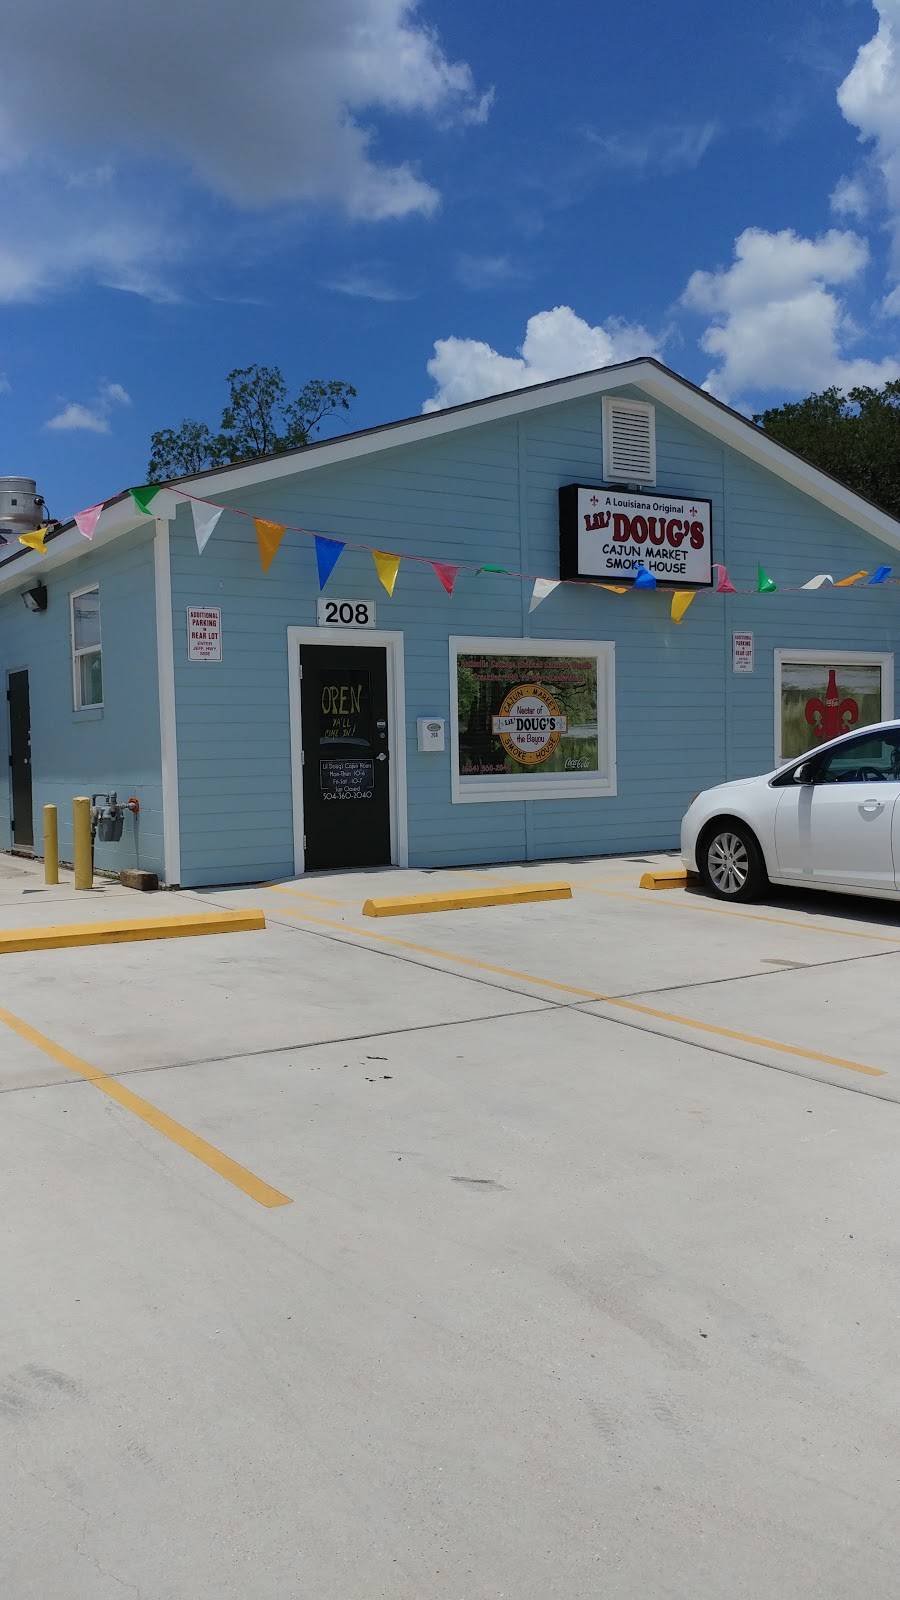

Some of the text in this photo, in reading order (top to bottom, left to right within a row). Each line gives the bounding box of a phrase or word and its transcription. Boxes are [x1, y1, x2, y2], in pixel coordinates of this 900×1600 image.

[605, 497, 684, 514] A Louisiana Original
[612, 513, 704, 549] DOUG'S
[602, 544, 688, 561] CAJUN MARKET
[648, 561, 686, 574] HOUSE
[190, 611, 219, 619] ADDITIONAL
[325, 602, 369, 624] 208
[191, 619, 217, 627] PARKING
[208, 632, 219, 640] LOT
[321, 684, 362, 715] OPEN
[503, 688, 556, 713] CAJUN MARKET
[536, 705, 543, 715] of
[516, 717, 556, 731] DOUG'S
[526, 733, 545, 745] Bayou
[504, 738, 556, 760] SMOKE HOUSE
